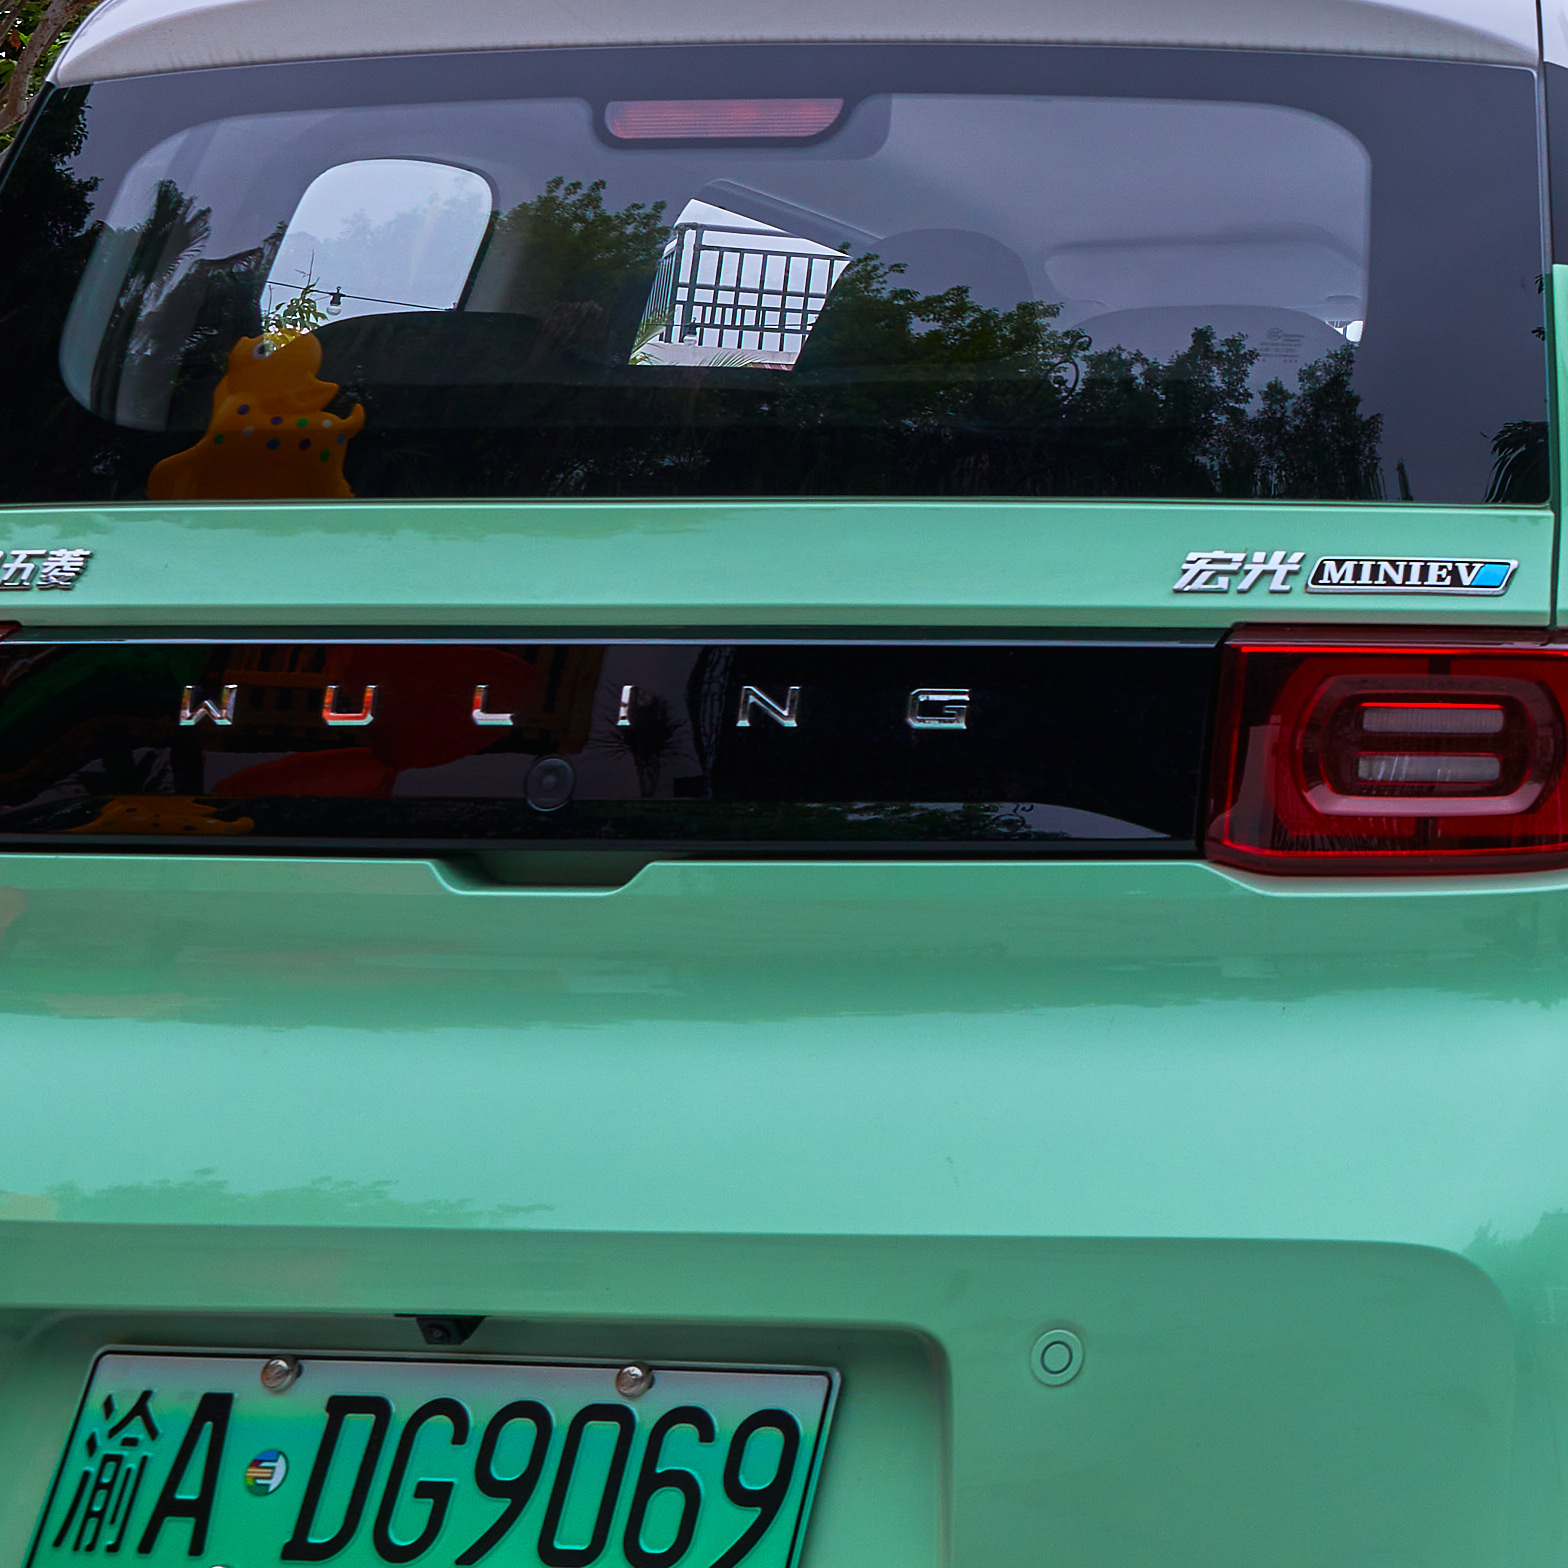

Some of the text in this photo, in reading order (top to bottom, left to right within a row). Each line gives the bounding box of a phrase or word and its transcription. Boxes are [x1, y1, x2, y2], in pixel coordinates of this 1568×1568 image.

[0, 549, 93, 590] 五菱
[1173, 550, 1488, 593] 宏光 MINIEV
[180, 683, 971, 731] WULING
